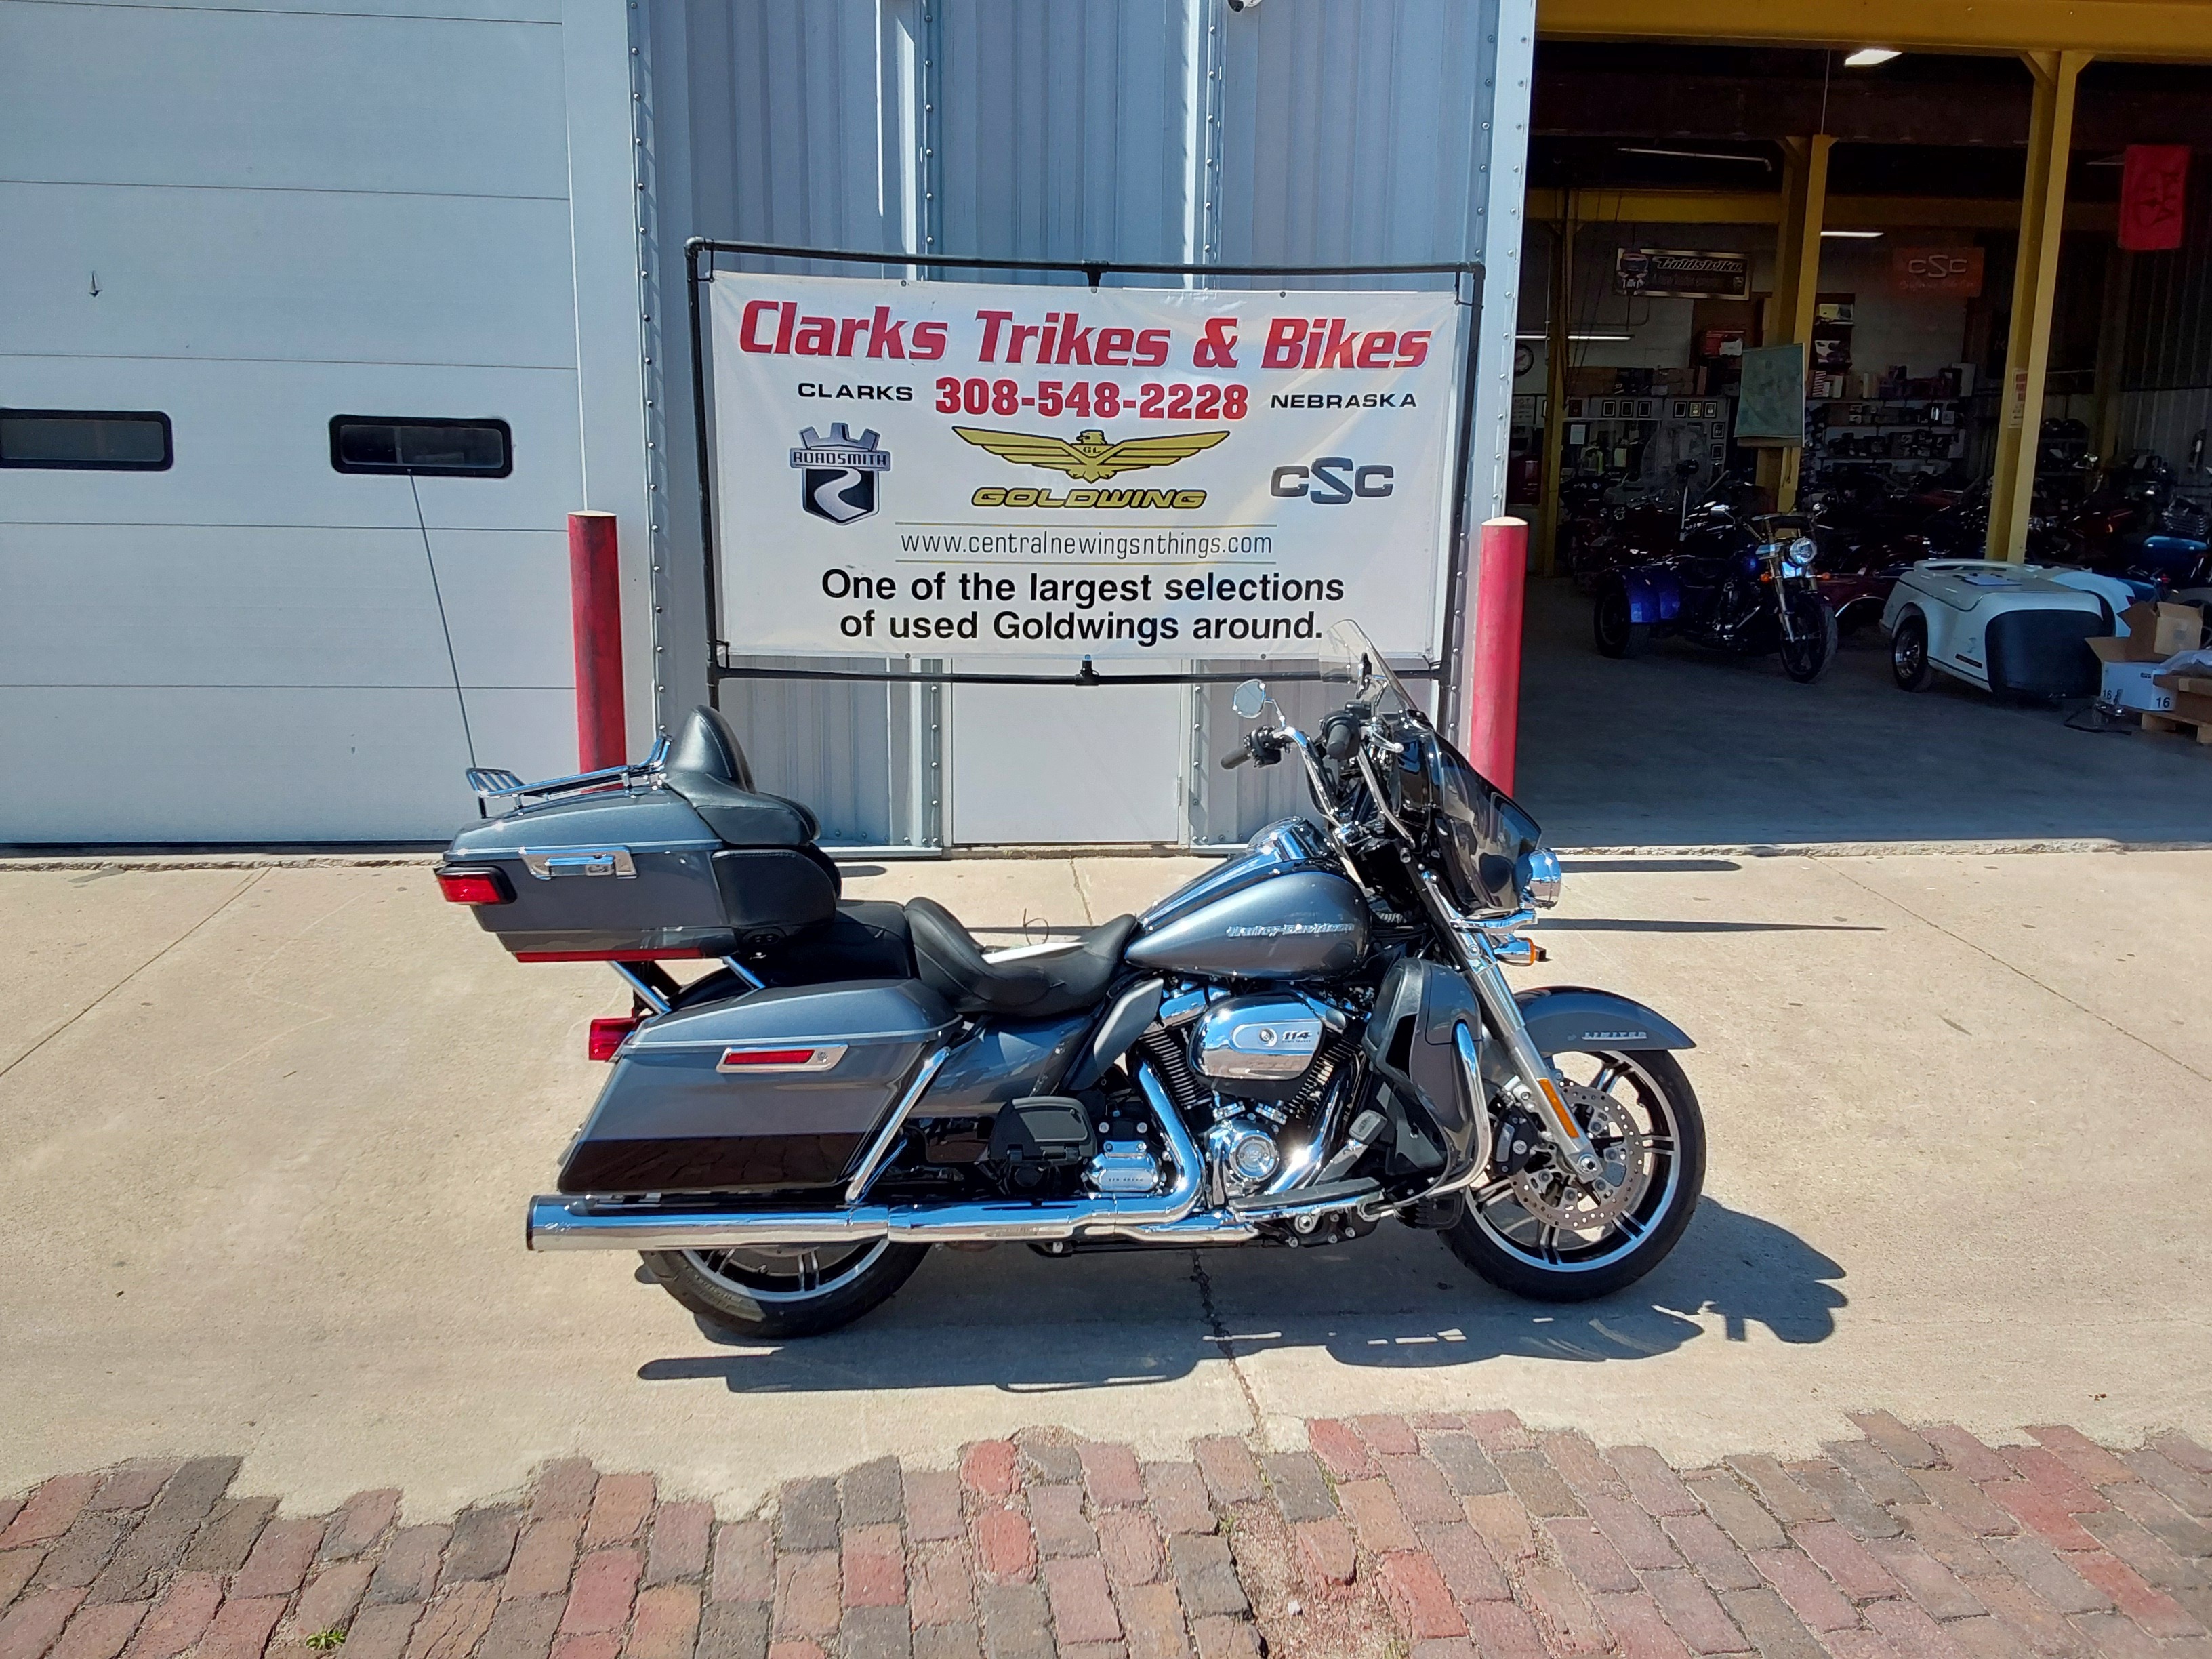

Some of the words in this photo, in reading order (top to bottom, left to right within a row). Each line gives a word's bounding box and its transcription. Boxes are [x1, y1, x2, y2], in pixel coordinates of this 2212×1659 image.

[739, 300, 949, 361] Clarks
[975, 310, 1171, 367] Trikes
[1193, 317, 1239, 369] &
[1261, 317, 1432, 370] Bikes
[798, 382, 913, 401] CLARKS
[935, 377, 1248, 419] 308-548-2228
[1271, 393, 1416, 409] NEBRASKA
[794, 451, 886, 466] ROADSMITH
[971, 487, 1206, 509] GOLDWING
[901, 531, 1272, 560] www.centralnewingsnthings.com
[822, 569, 896, 600] One
[911, 571, 945, 601] of
[959, 572, 1015, 601] the
[1031, 573, 1151, 609] largest
[1164, 572, 1344, 602] selections
[840, 609, 875, 638] of
[890, 611, 977, 639] used
[994, 611, 1179, 647] Goldwings
[1193, 611, 1322, 640] around.
[2102, 689, 2112, 700] 16
[2156, 697, 2171, 708] 16
[1282, 1030, 1312, 1041] 114
